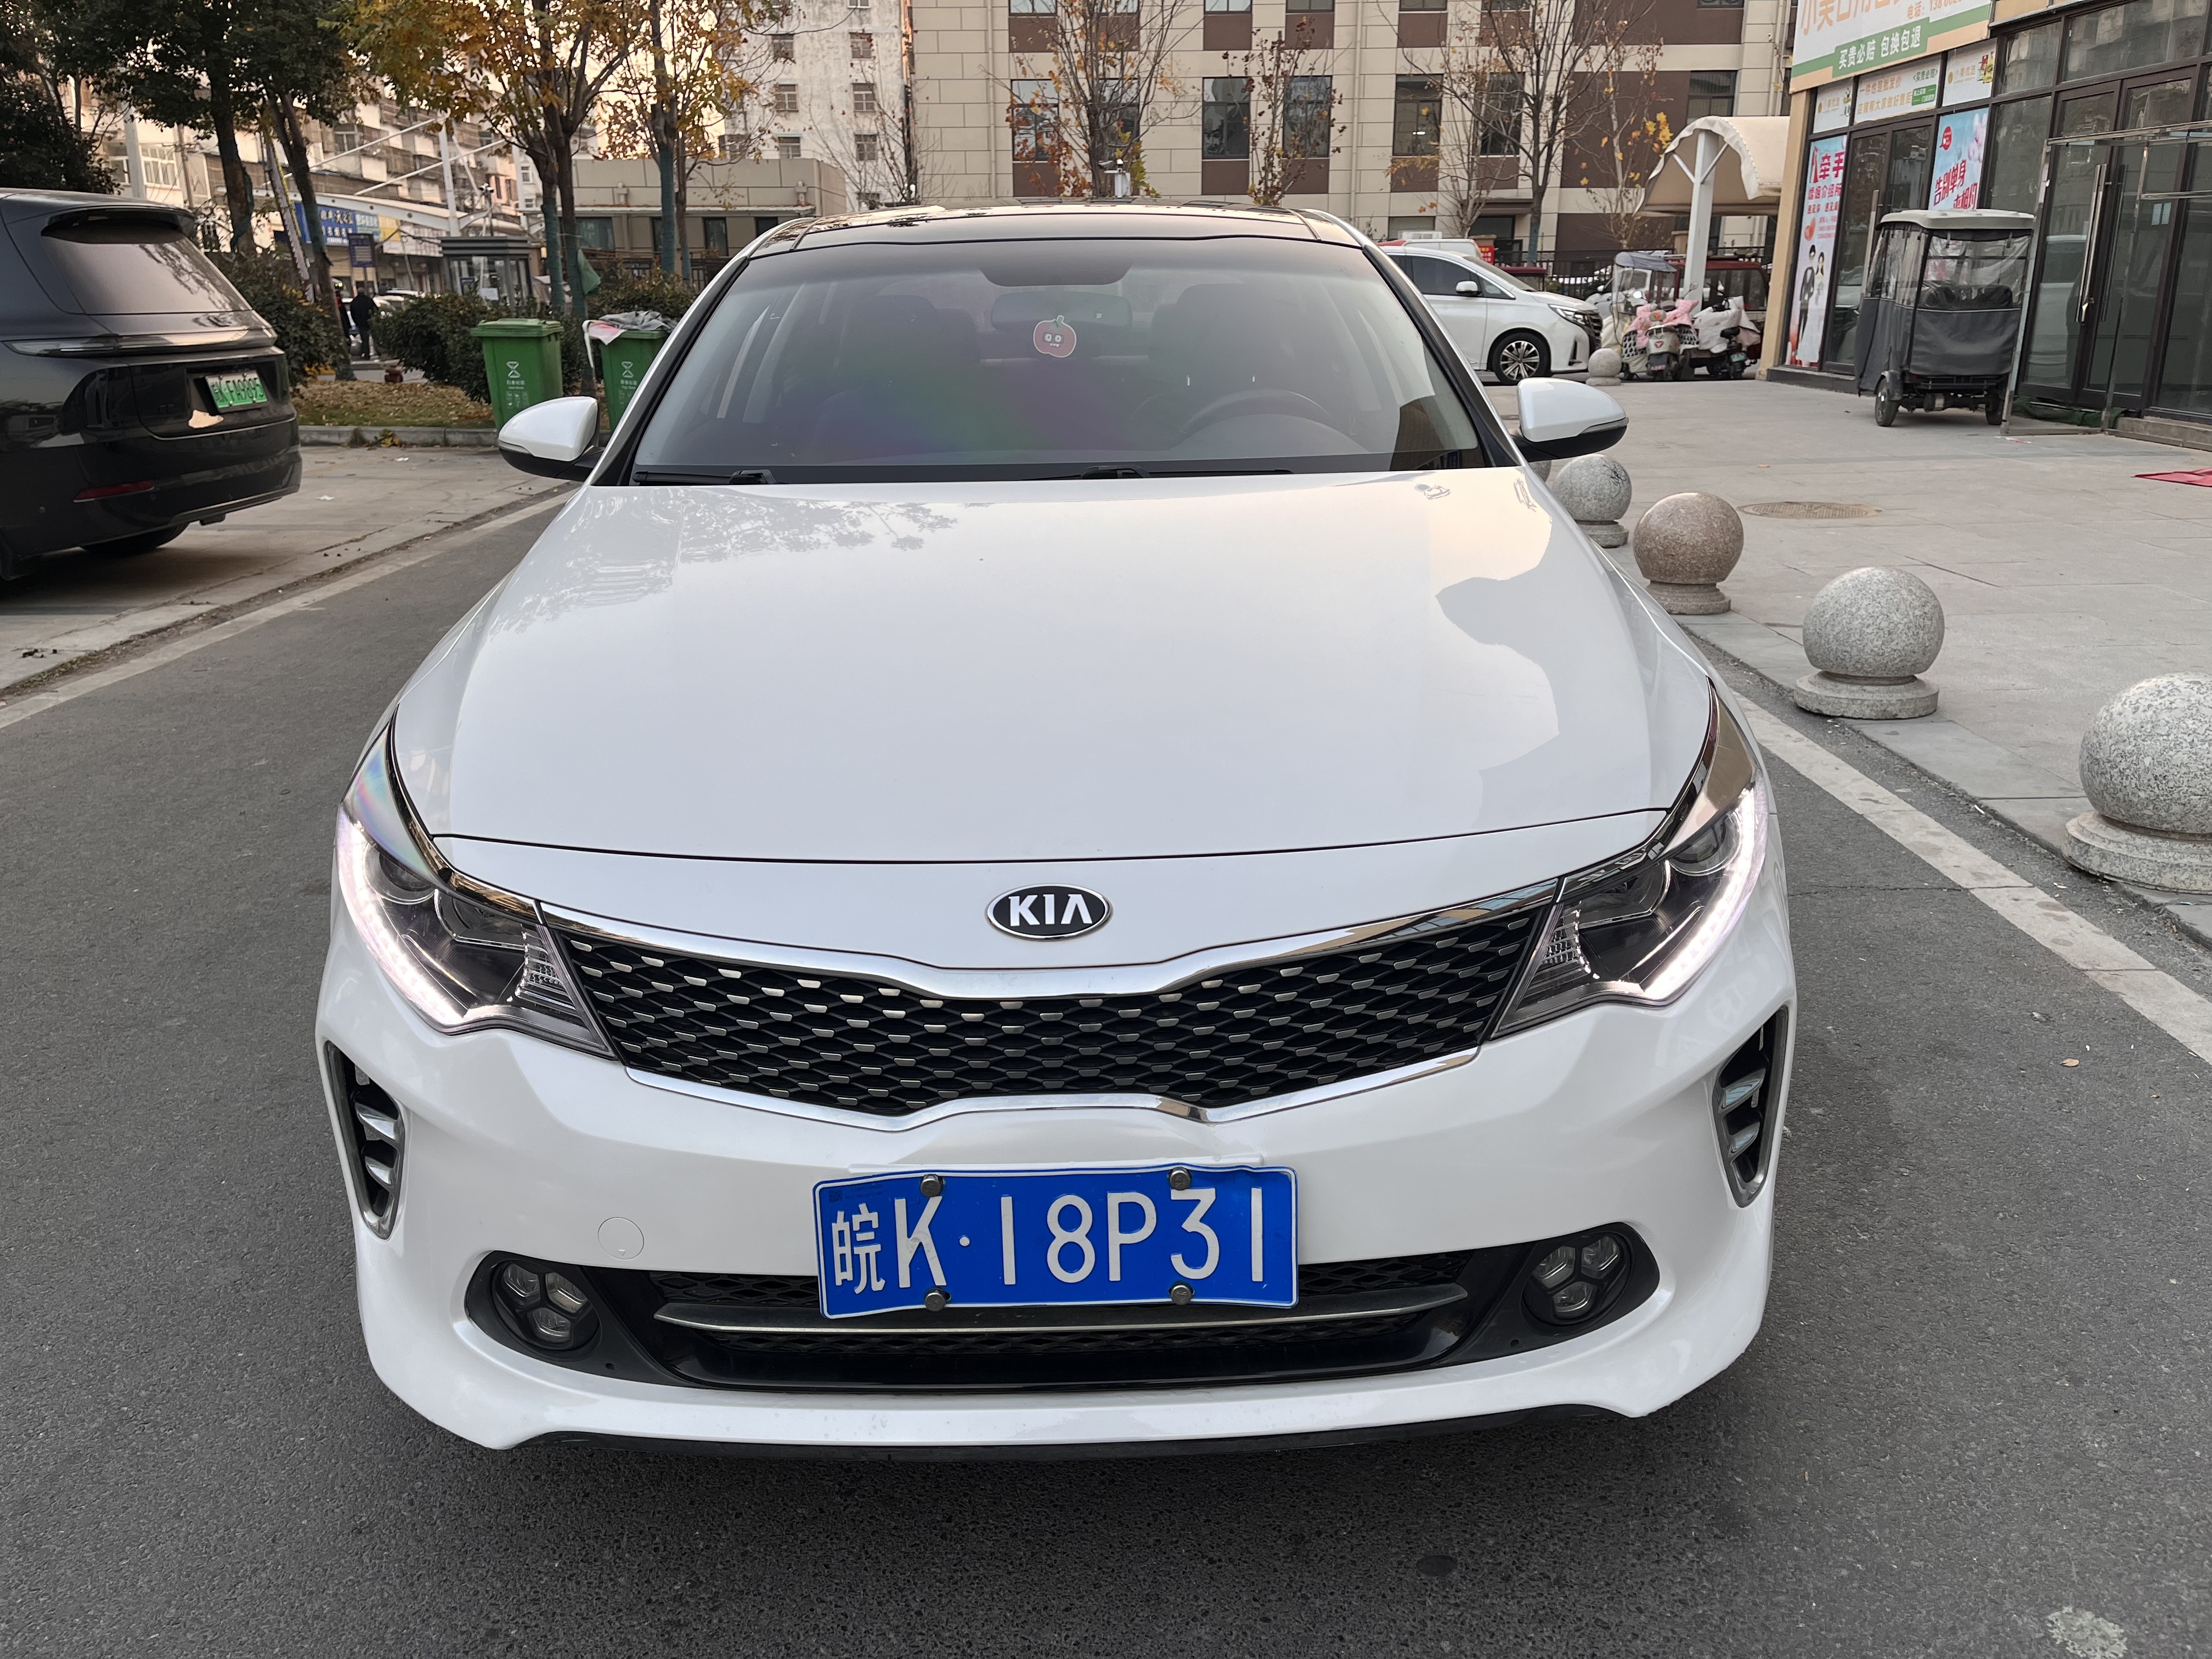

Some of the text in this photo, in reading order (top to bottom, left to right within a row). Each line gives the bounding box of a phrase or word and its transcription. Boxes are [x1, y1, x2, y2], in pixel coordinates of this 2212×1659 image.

[1839, 25, 1921, 70] 买贵必赔 包换包退
[1819, 151, 1846, 179] 牵手
[1934, 159, 1966, 206] 告别单身
[1008, 894, 1093, 927] KIA
